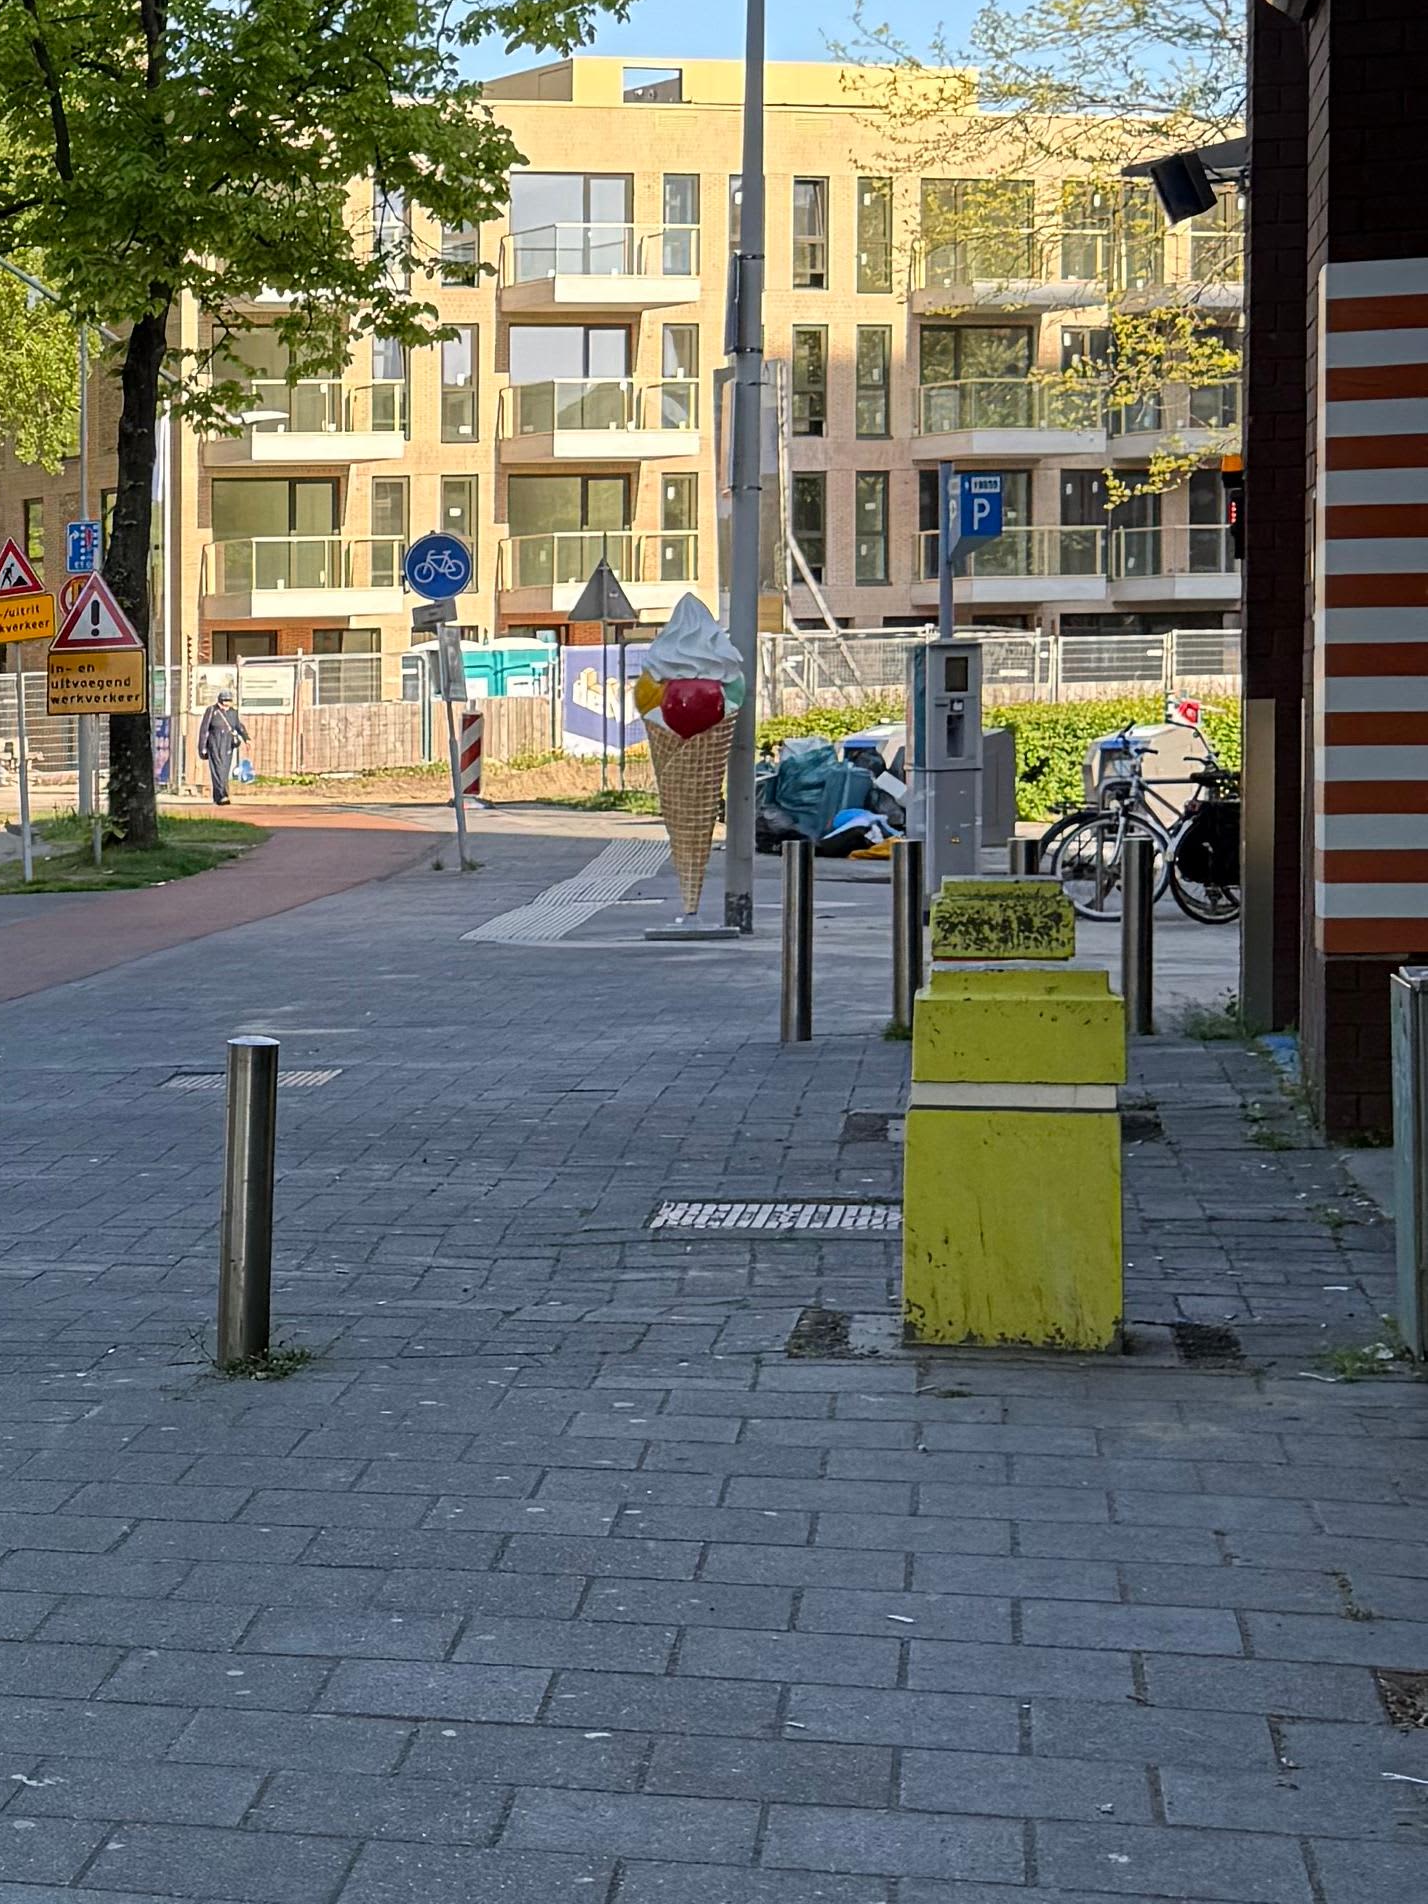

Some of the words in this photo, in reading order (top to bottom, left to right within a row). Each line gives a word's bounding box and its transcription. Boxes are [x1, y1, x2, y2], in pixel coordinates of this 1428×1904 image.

[973, 498, 990, 530] P
[51, 676, 131, 690] uitvoegend
[50, 692, 140, 705] werkverkeer
